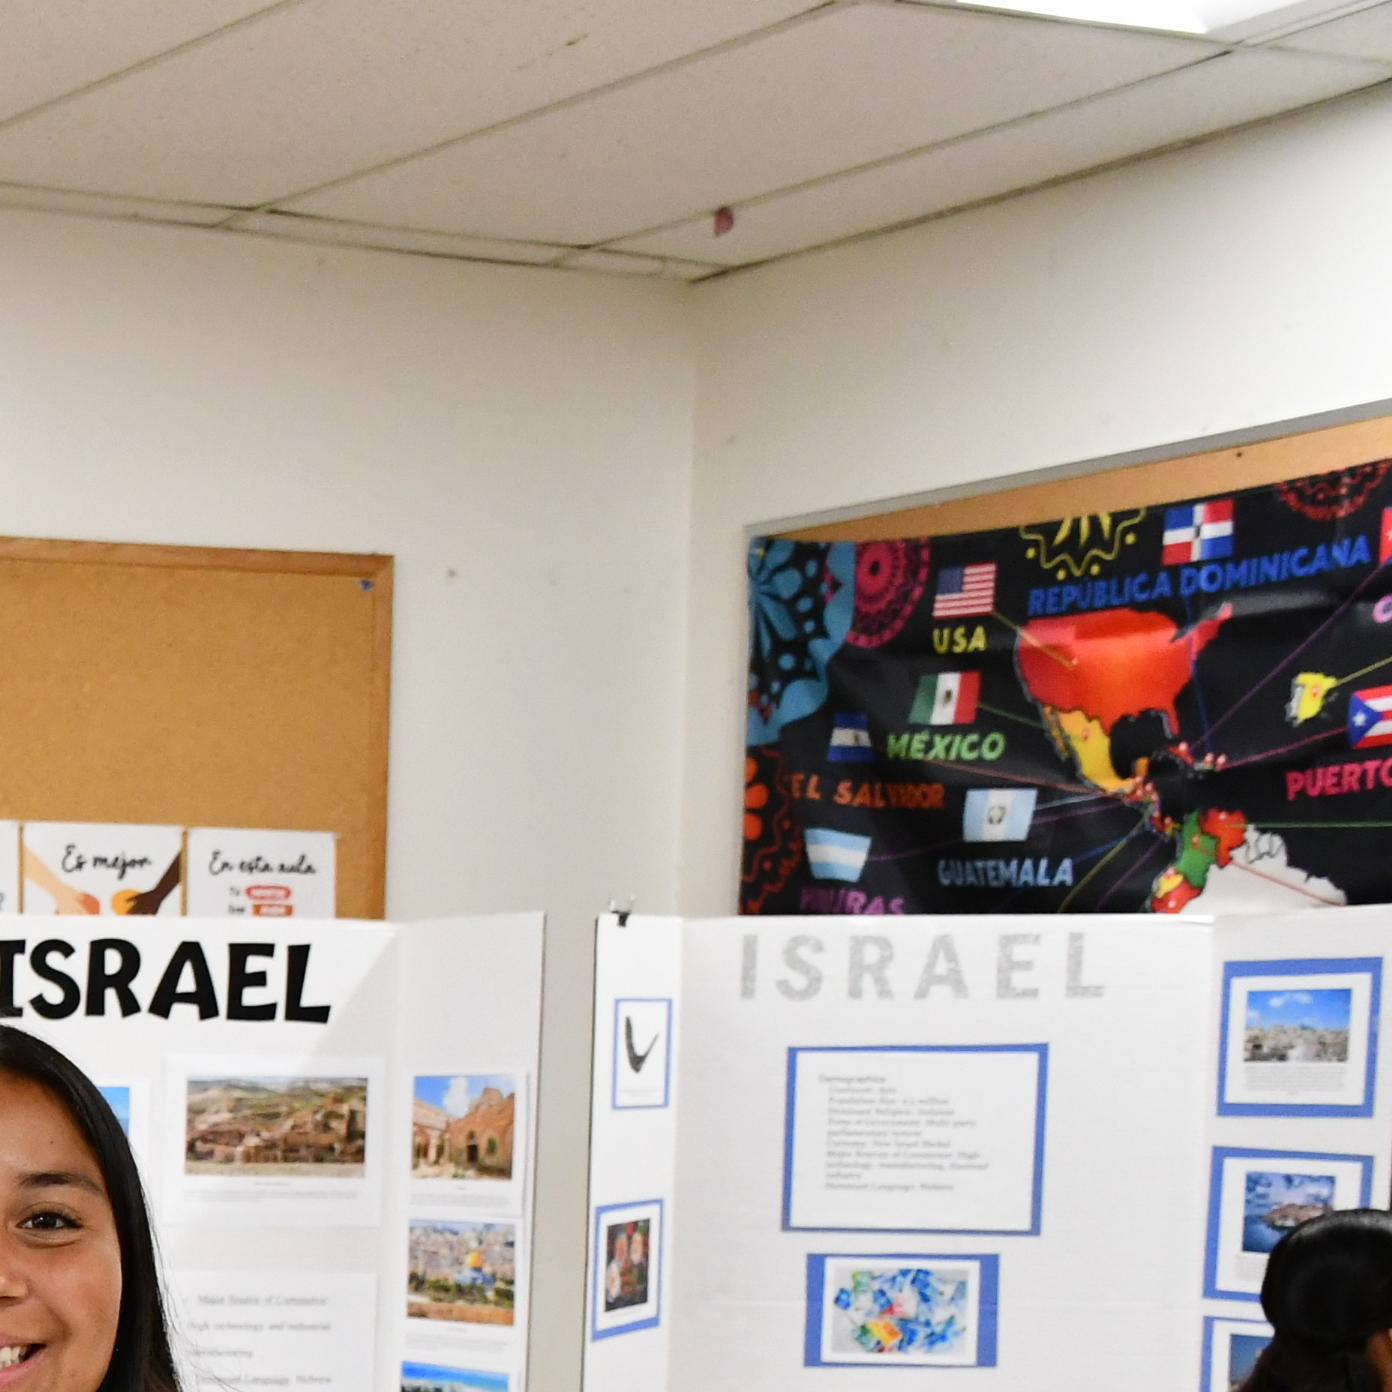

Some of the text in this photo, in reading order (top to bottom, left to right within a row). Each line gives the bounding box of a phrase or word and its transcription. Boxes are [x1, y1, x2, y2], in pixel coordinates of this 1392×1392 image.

[1180, 534, 1371, 597] DOMINICANA
[933, 625, 987, 654] USA
[62, 845, 152, 880] Es mejor
[209, 849, 317, 876] En esta aula
[937, 857, 1074, 889] GUATEMALA
[738, 932, 1105, 1002] ISRAEL
